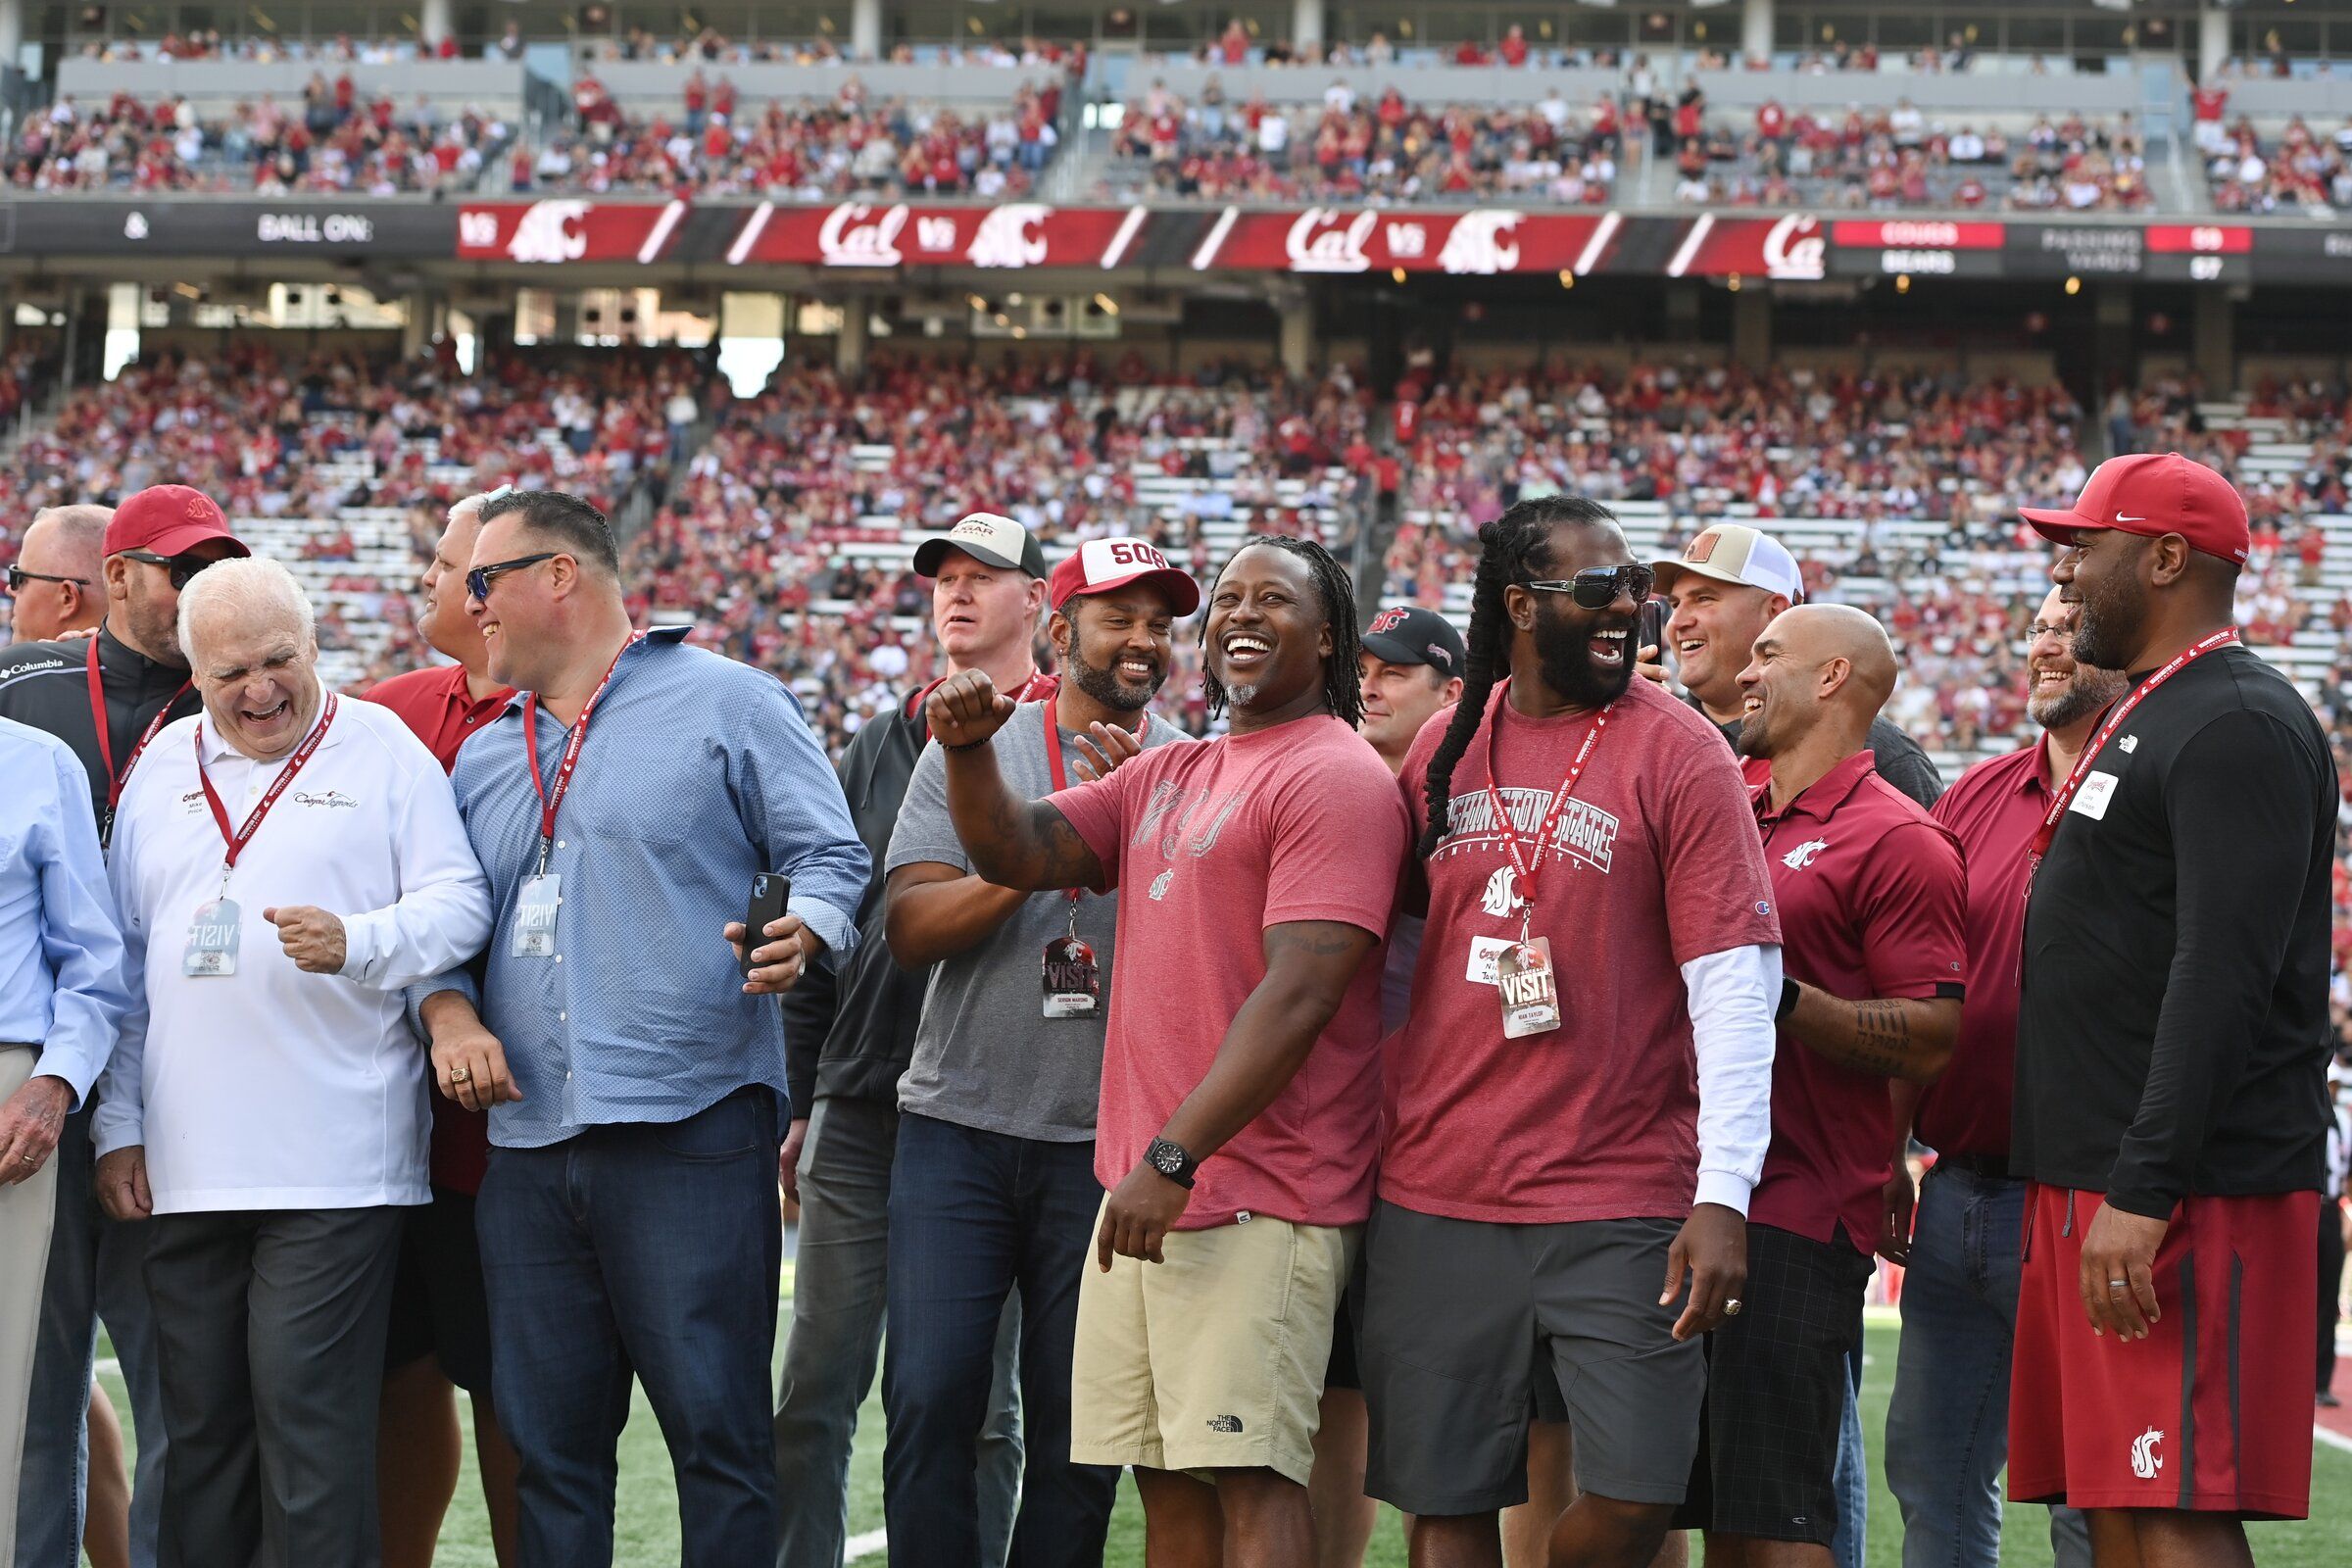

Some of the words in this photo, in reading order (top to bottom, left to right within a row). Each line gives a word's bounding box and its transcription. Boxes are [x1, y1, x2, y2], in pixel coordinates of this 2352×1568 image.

[258, 214, 322, 241] BALL
[818, 201, 909, 266] Cal
[1286, 207, 1378, 272] Cal
[1882, 250, 1955, 274] BEARS
[10, 659, 64, 674] Columbia
[1500, 972, 1549, 1006] VISIT
